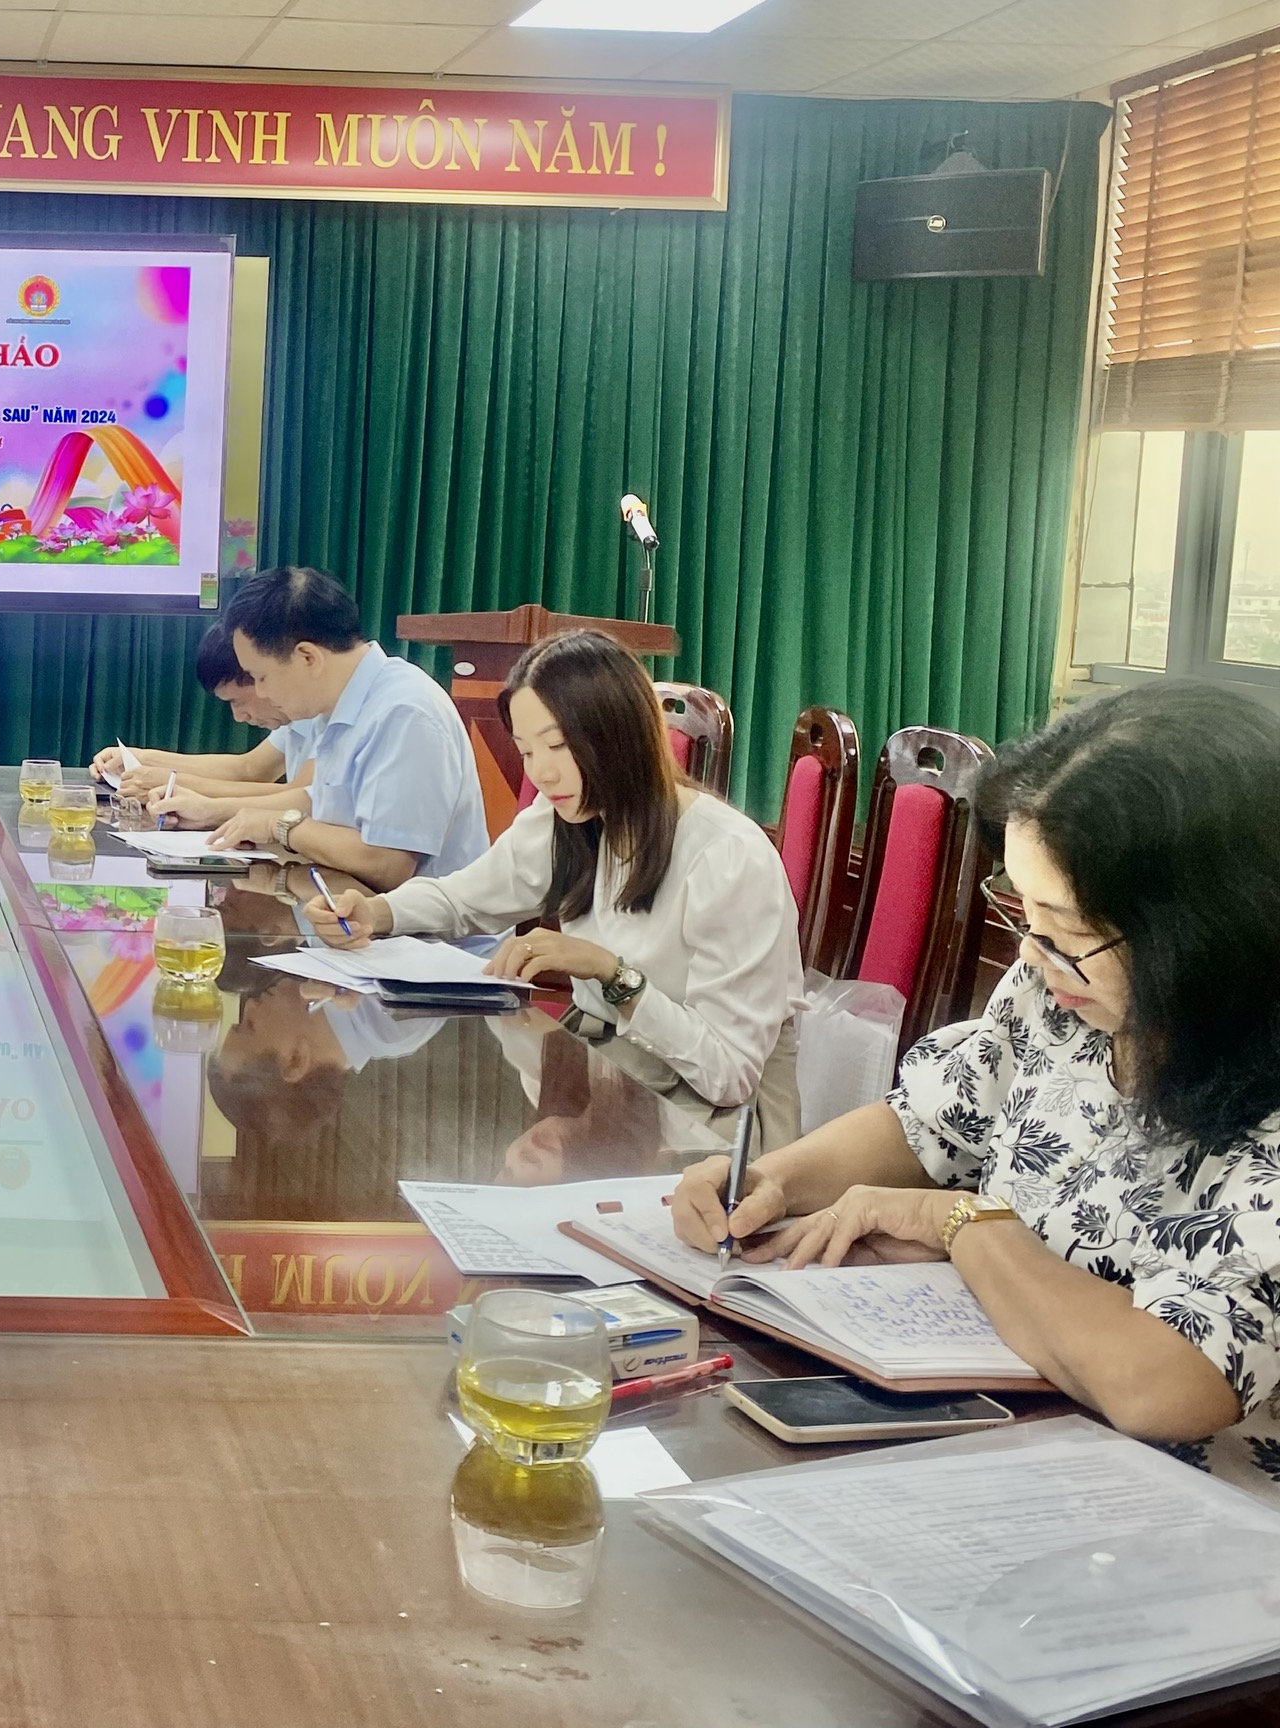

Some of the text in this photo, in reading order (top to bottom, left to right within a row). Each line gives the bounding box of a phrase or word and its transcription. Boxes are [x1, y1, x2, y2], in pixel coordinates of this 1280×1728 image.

[140, 107, 291, 166] VINH
[314, 98, 487, 173] MUÔN
[505, 105, 636, 176] NĂM
[654, 124, 668, 177] !
[43, 407, 77, 423] NĂM
[81, 410, 116, 424] 2024
